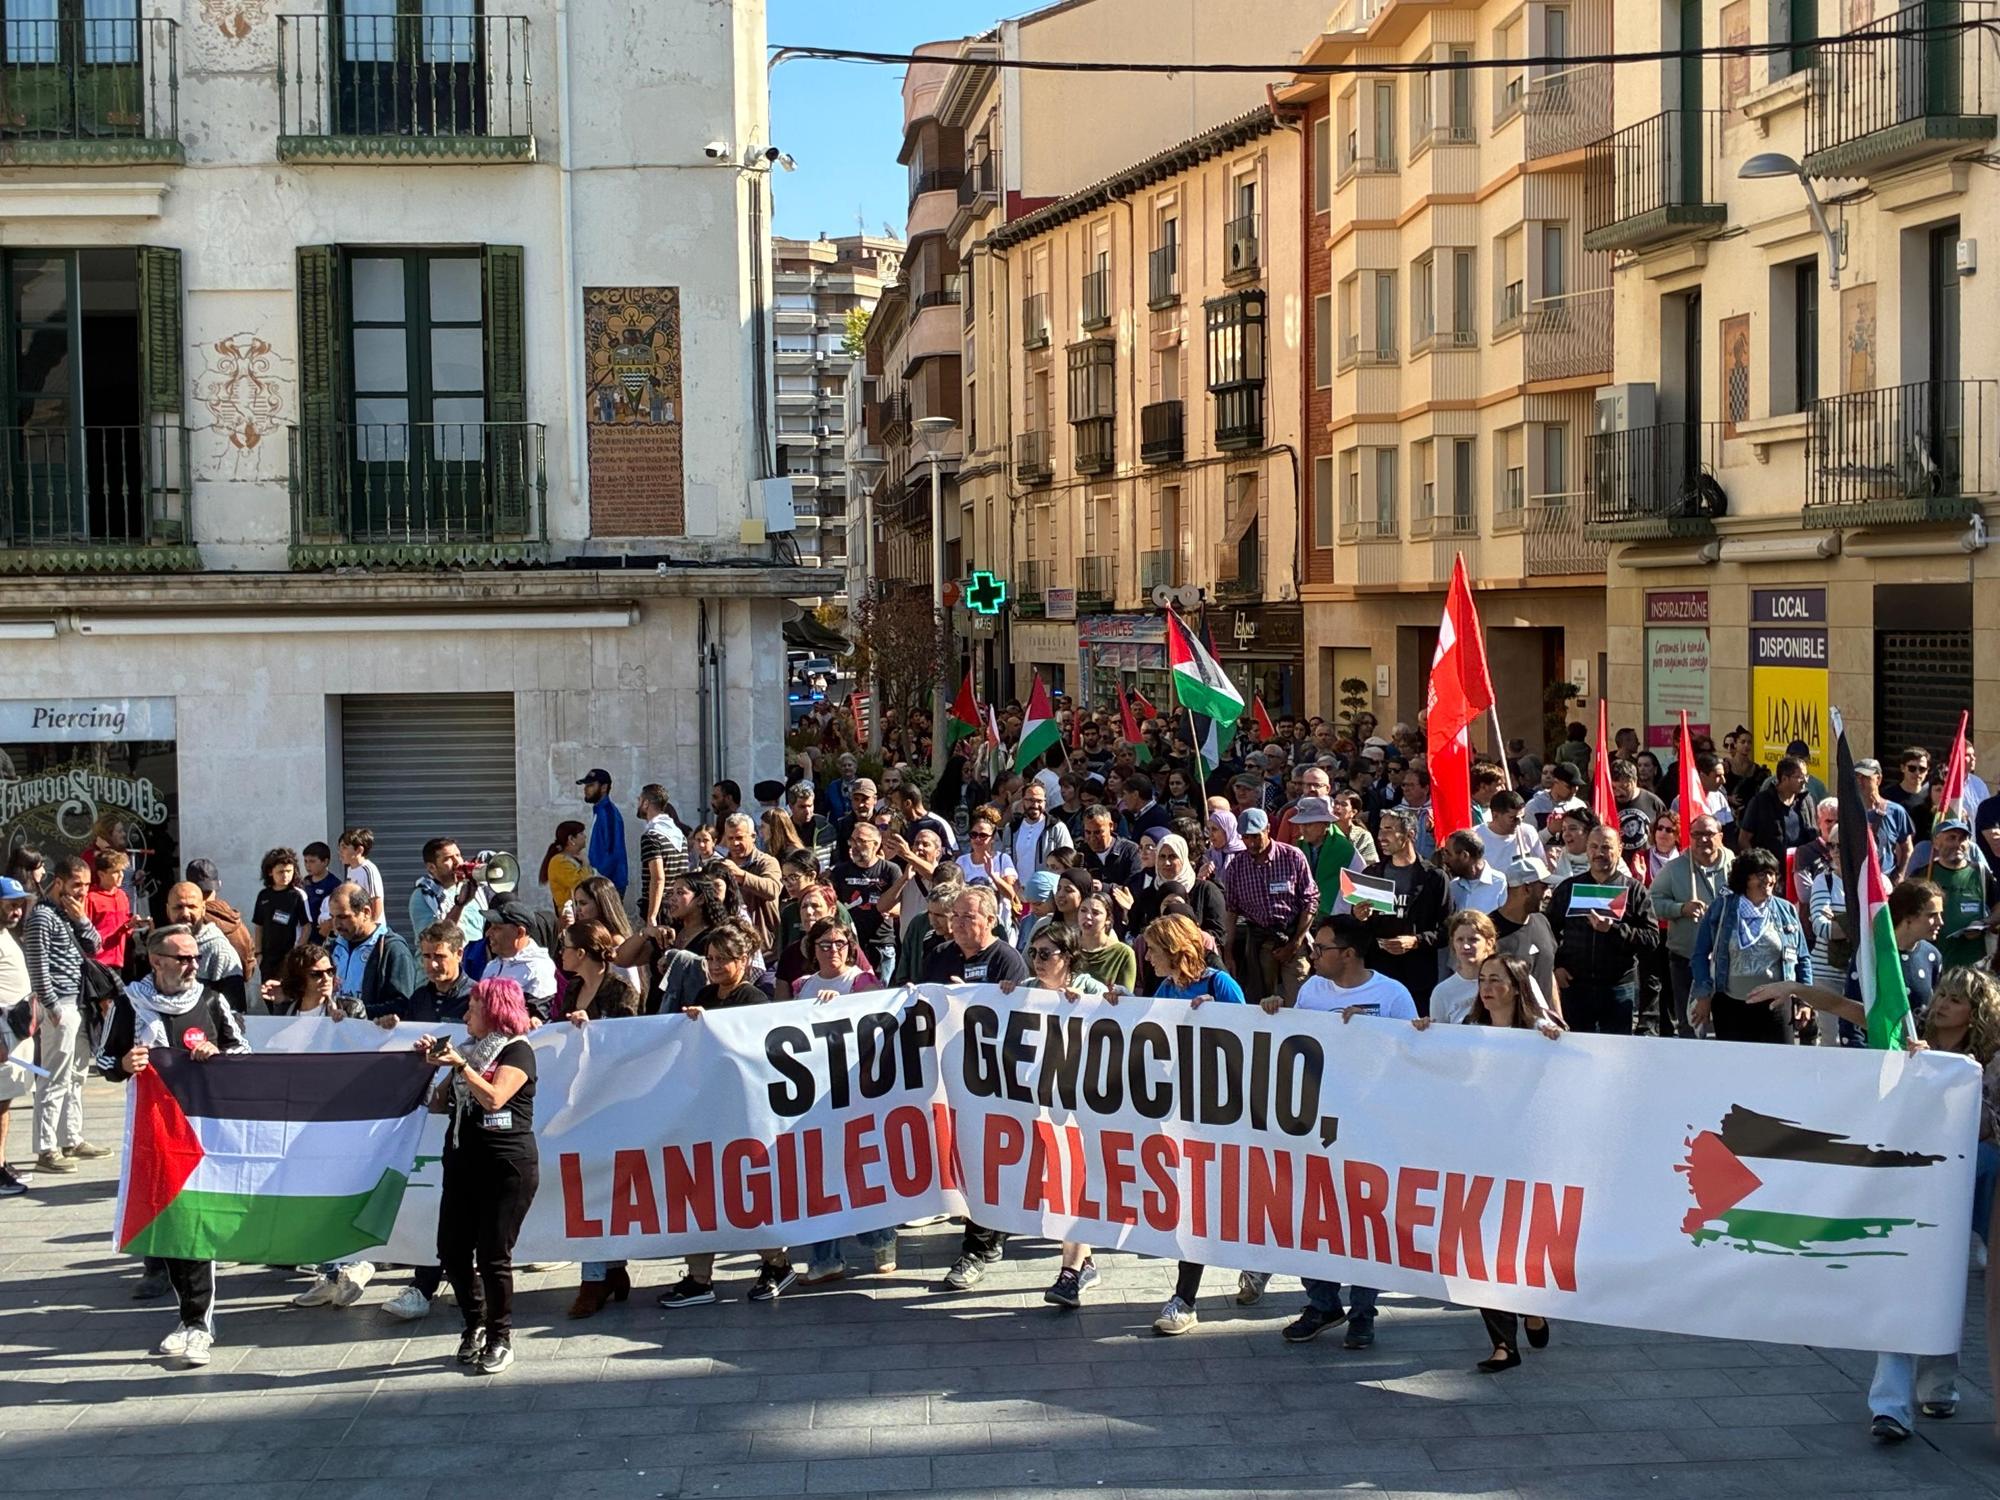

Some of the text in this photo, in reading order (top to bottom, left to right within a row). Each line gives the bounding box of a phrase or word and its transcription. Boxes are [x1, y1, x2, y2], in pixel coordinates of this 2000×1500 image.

[1772, 596, 1809, 618] LOCAL
[1759, 636, 1825, 659] DISPONIBLE
[32, 706, 127, 735] Piercing
[1763, 696, 1820, 747] JARAMA
[766, 999, 1339, 1149] STOP GENOCIDIO,
[560, 1103, 1585, 1292] LANGILEOK PALESTINAREKIN
